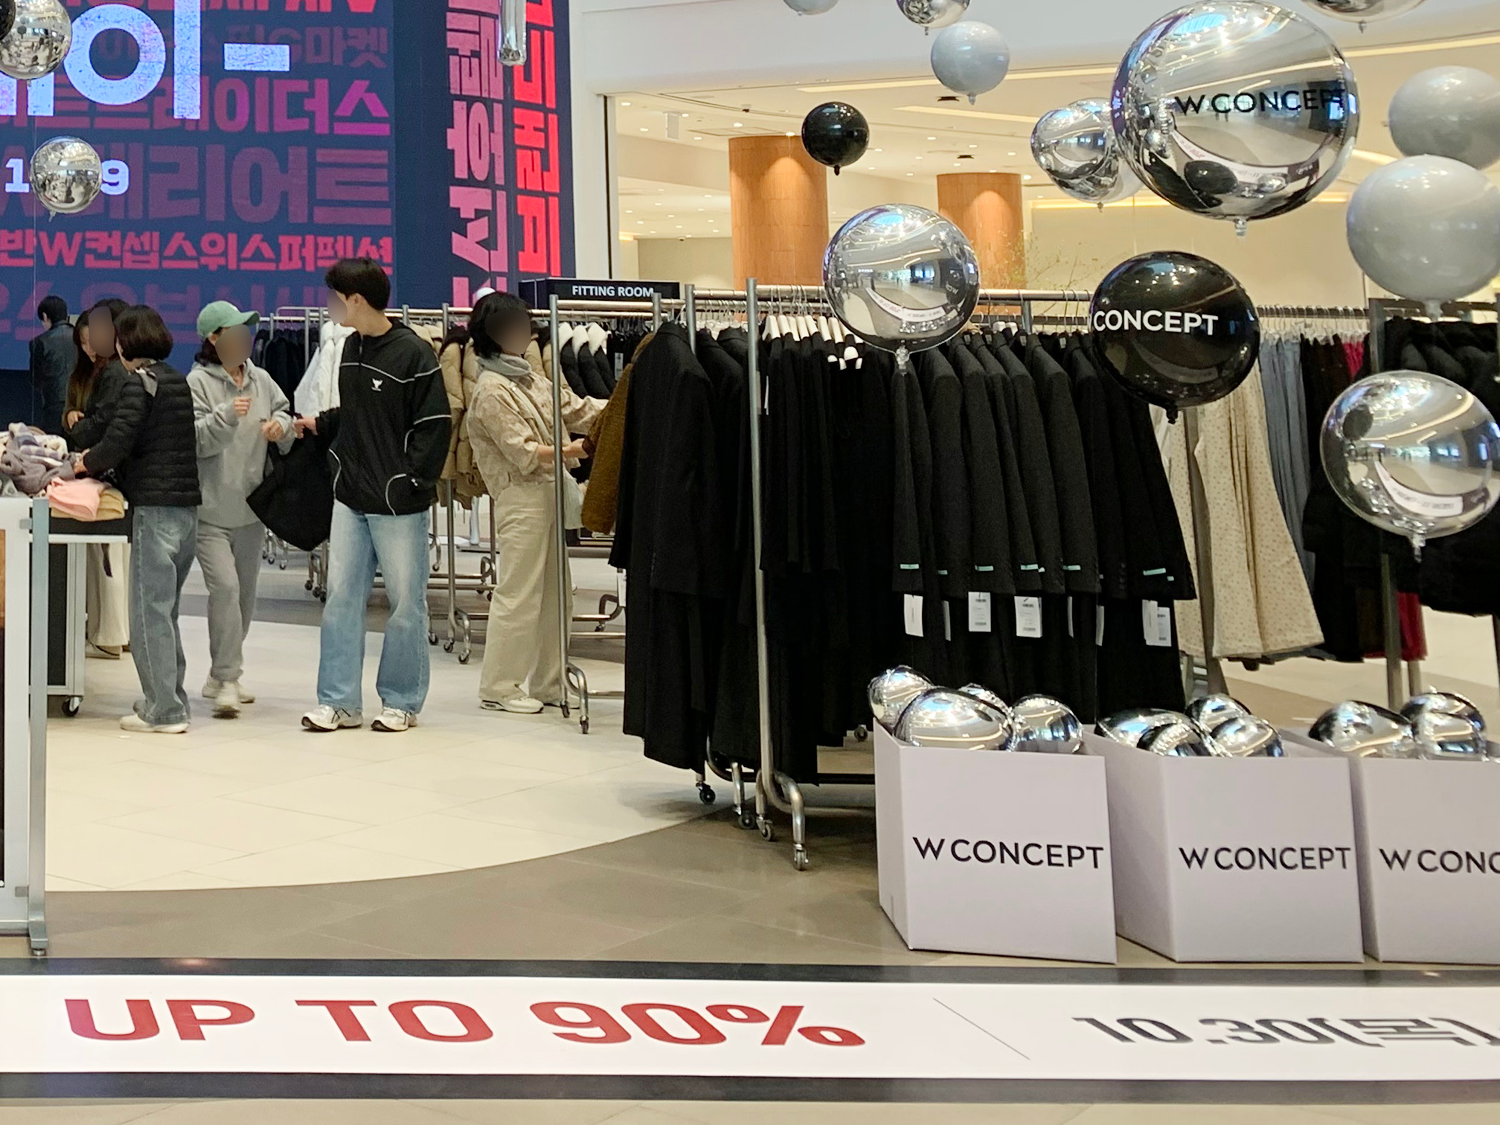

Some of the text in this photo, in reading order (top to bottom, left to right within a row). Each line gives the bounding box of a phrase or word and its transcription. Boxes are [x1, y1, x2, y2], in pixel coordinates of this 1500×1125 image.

[571, 285, 654, 298] FITTING ROOM
[1092, 308, 1219, 337] CONCEPT
[950, 839, 1105, 870] CONCEPT
[1214, 846, 1352, 871] CONCEPT
[63, 998, 256, 1041] UP
[294, 999, 494, 1044] TO
[528, 1000, 867, 1047] 90%
